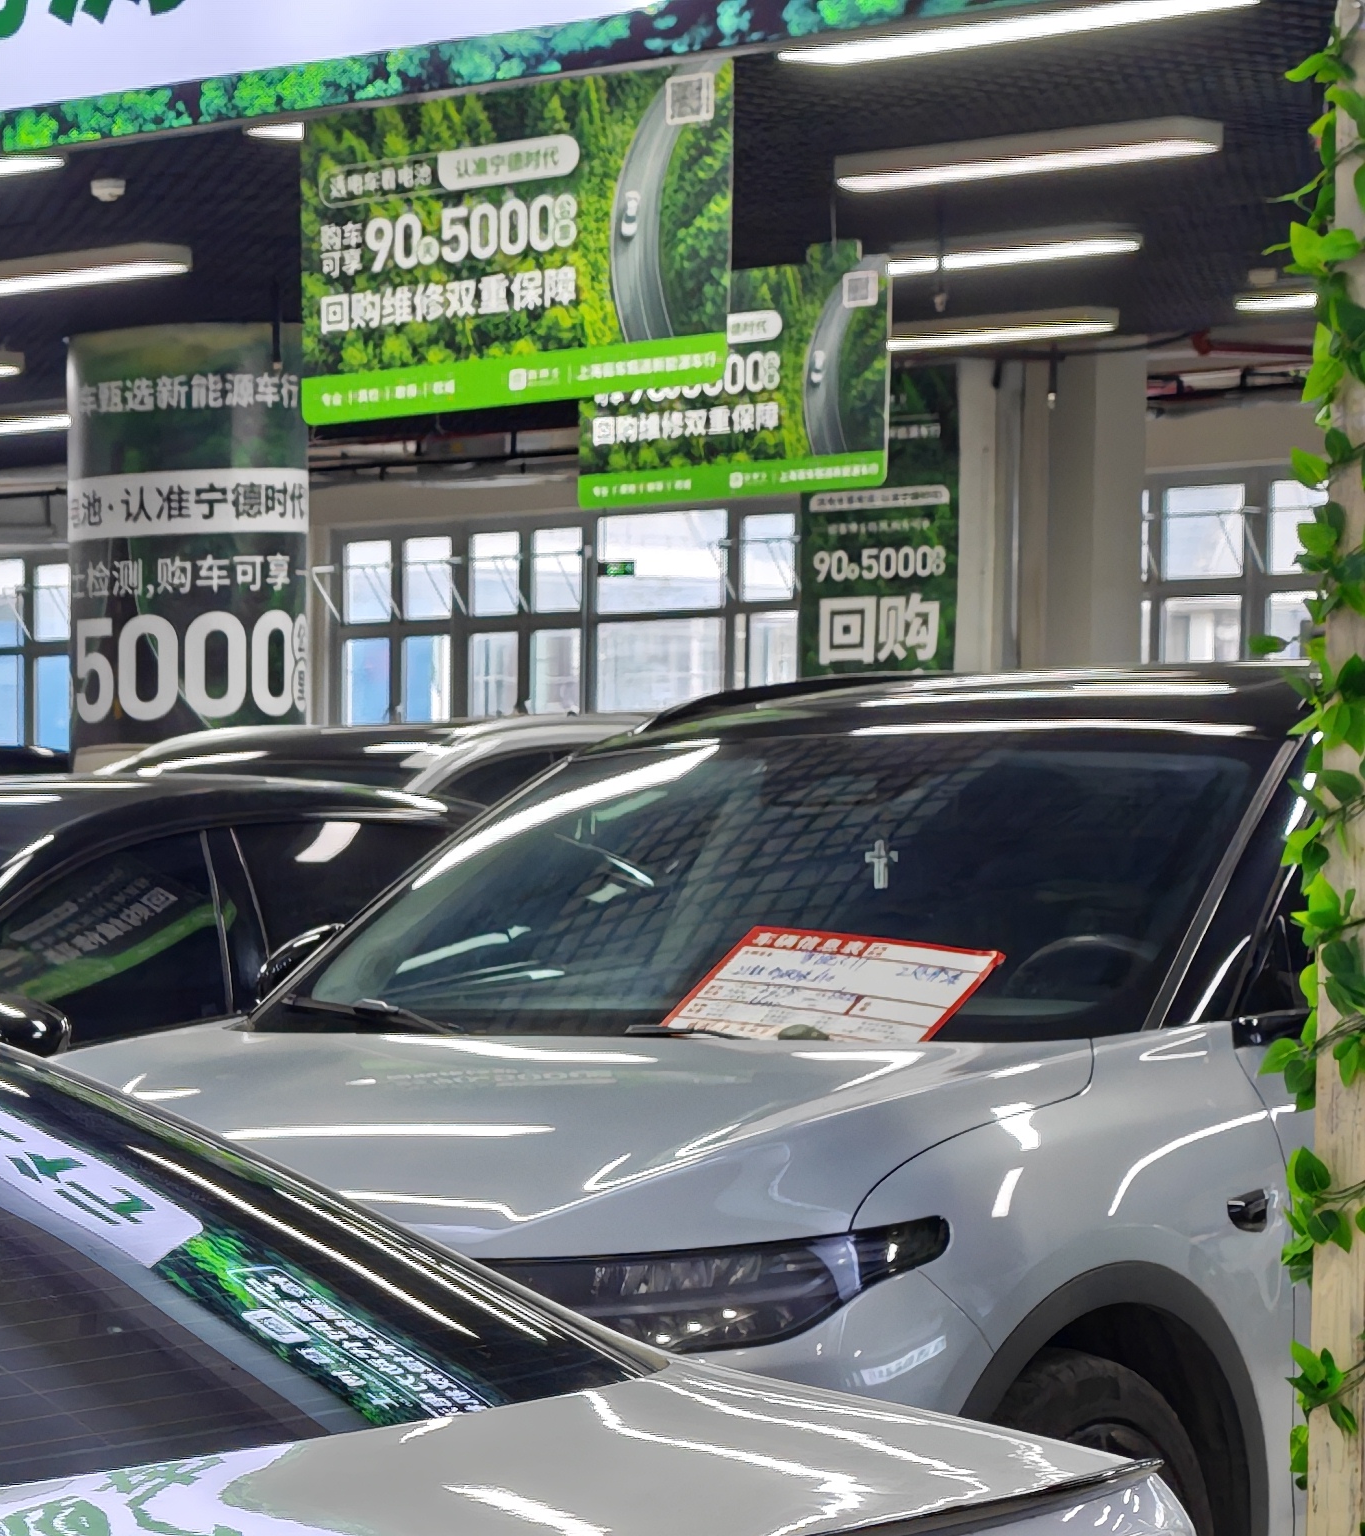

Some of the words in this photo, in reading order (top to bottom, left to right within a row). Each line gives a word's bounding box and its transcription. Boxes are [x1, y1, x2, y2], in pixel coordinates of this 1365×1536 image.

[320, 265, 578, 335] 回购维修双重保障
[819, 592, 940, 665] 回购
